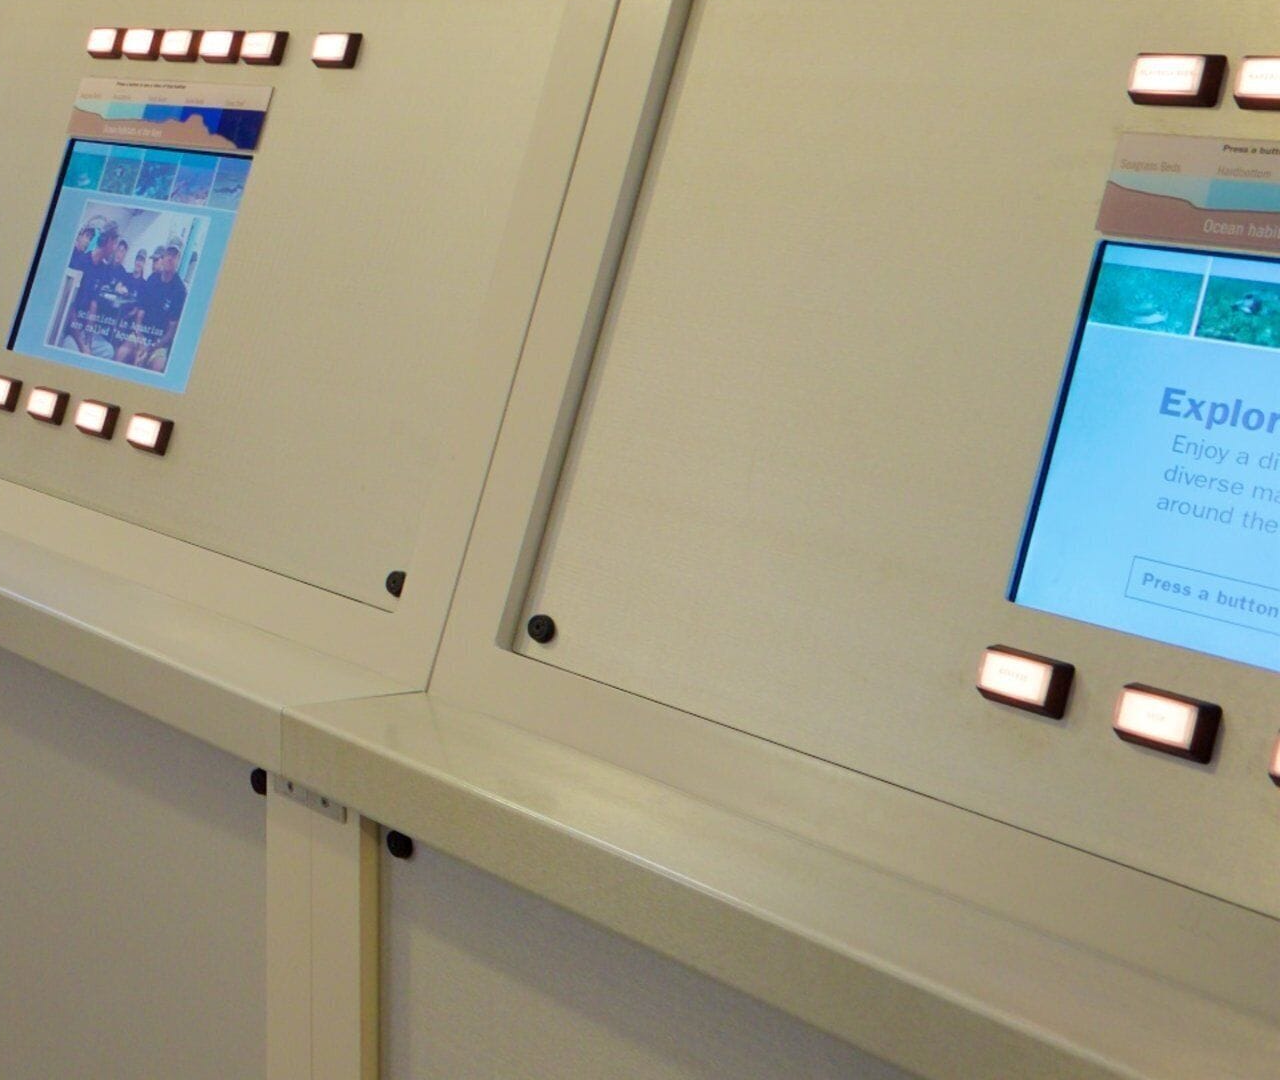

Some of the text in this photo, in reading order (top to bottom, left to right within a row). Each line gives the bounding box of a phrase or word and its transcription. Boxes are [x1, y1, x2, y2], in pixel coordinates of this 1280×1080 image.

[1222, 144, 1248, 154] Press
[1216, 165, 1272, 178] Hardbottom
[1203, 219, 1244, 235] Ocean
[1171, 434, 1230, 465] Enjoy
[1236, 451, 1250, 465] a
[1164, 465, 1244, 496] diverse
[1156, 496, 1279, 534] around the
[1142, 572, 1280, 619] Press a button
